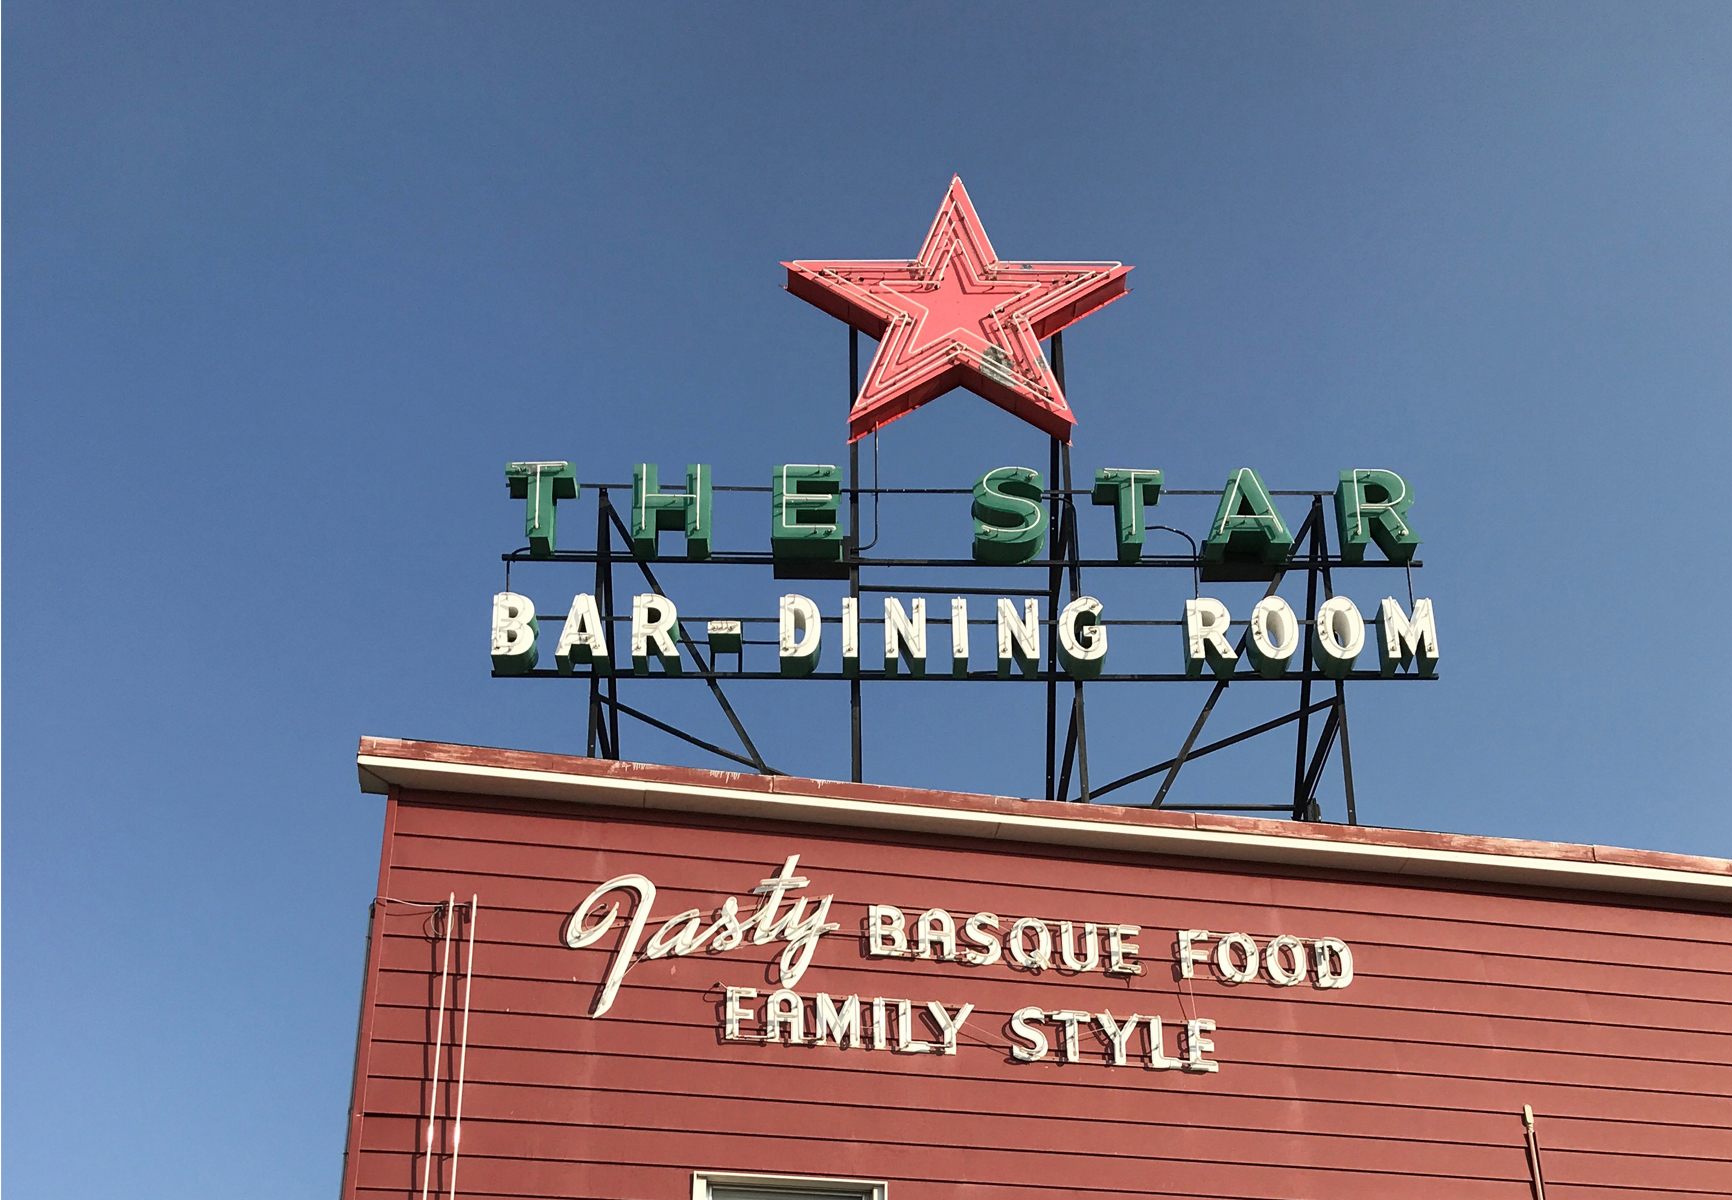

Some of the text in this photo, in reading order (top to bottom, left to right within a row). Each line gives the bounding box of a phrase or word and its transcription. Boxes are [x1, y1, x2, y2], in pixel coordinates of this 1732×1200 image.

[505, 461, 1424, 563] THE STAR
[1183, 595, 1440, 677] ROOM
[566, 853, 1354, 1019] Tasty BASQUE FOOD
[725, 986, 1219, 1073] FAMILY STYLE
